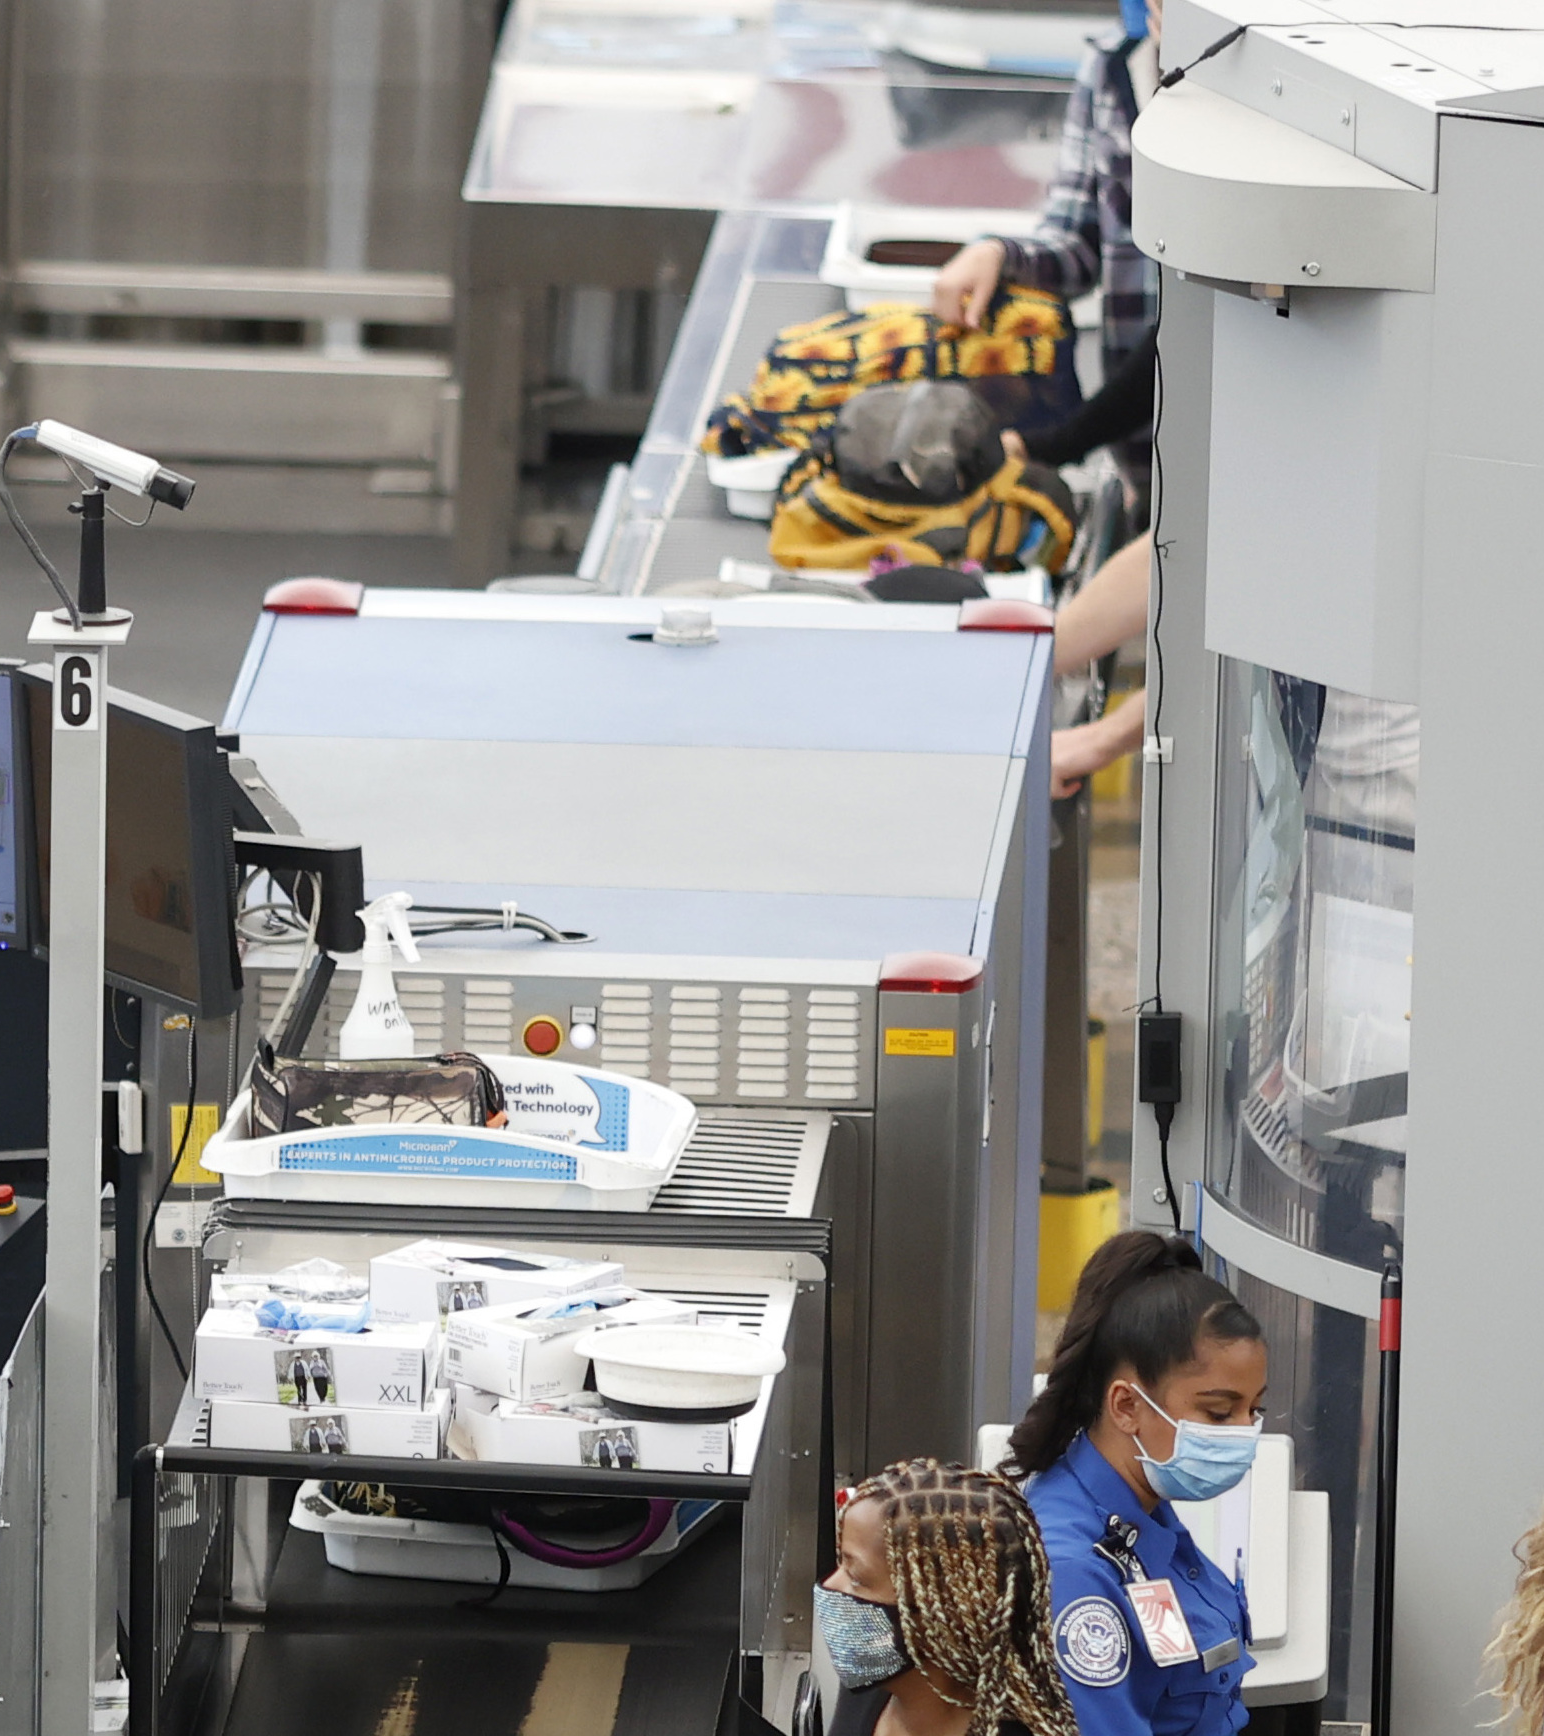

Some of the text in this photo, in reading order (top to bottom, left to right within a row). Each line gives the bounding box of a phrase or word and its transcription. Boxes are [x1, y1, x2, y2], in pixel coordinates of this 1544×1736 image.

[59, 657, 92, 727] 6
[525, 1084, 554, 1095] with
[514, 1100, 594, 1116] Technology
[286, 1150, 569, 1170] EXPERTS IN ANTIMICROBIAL PRODUCT PROTECTION
[379, 1385, 416, 1403] XXL
[509, 1378, 515, 1394] L
